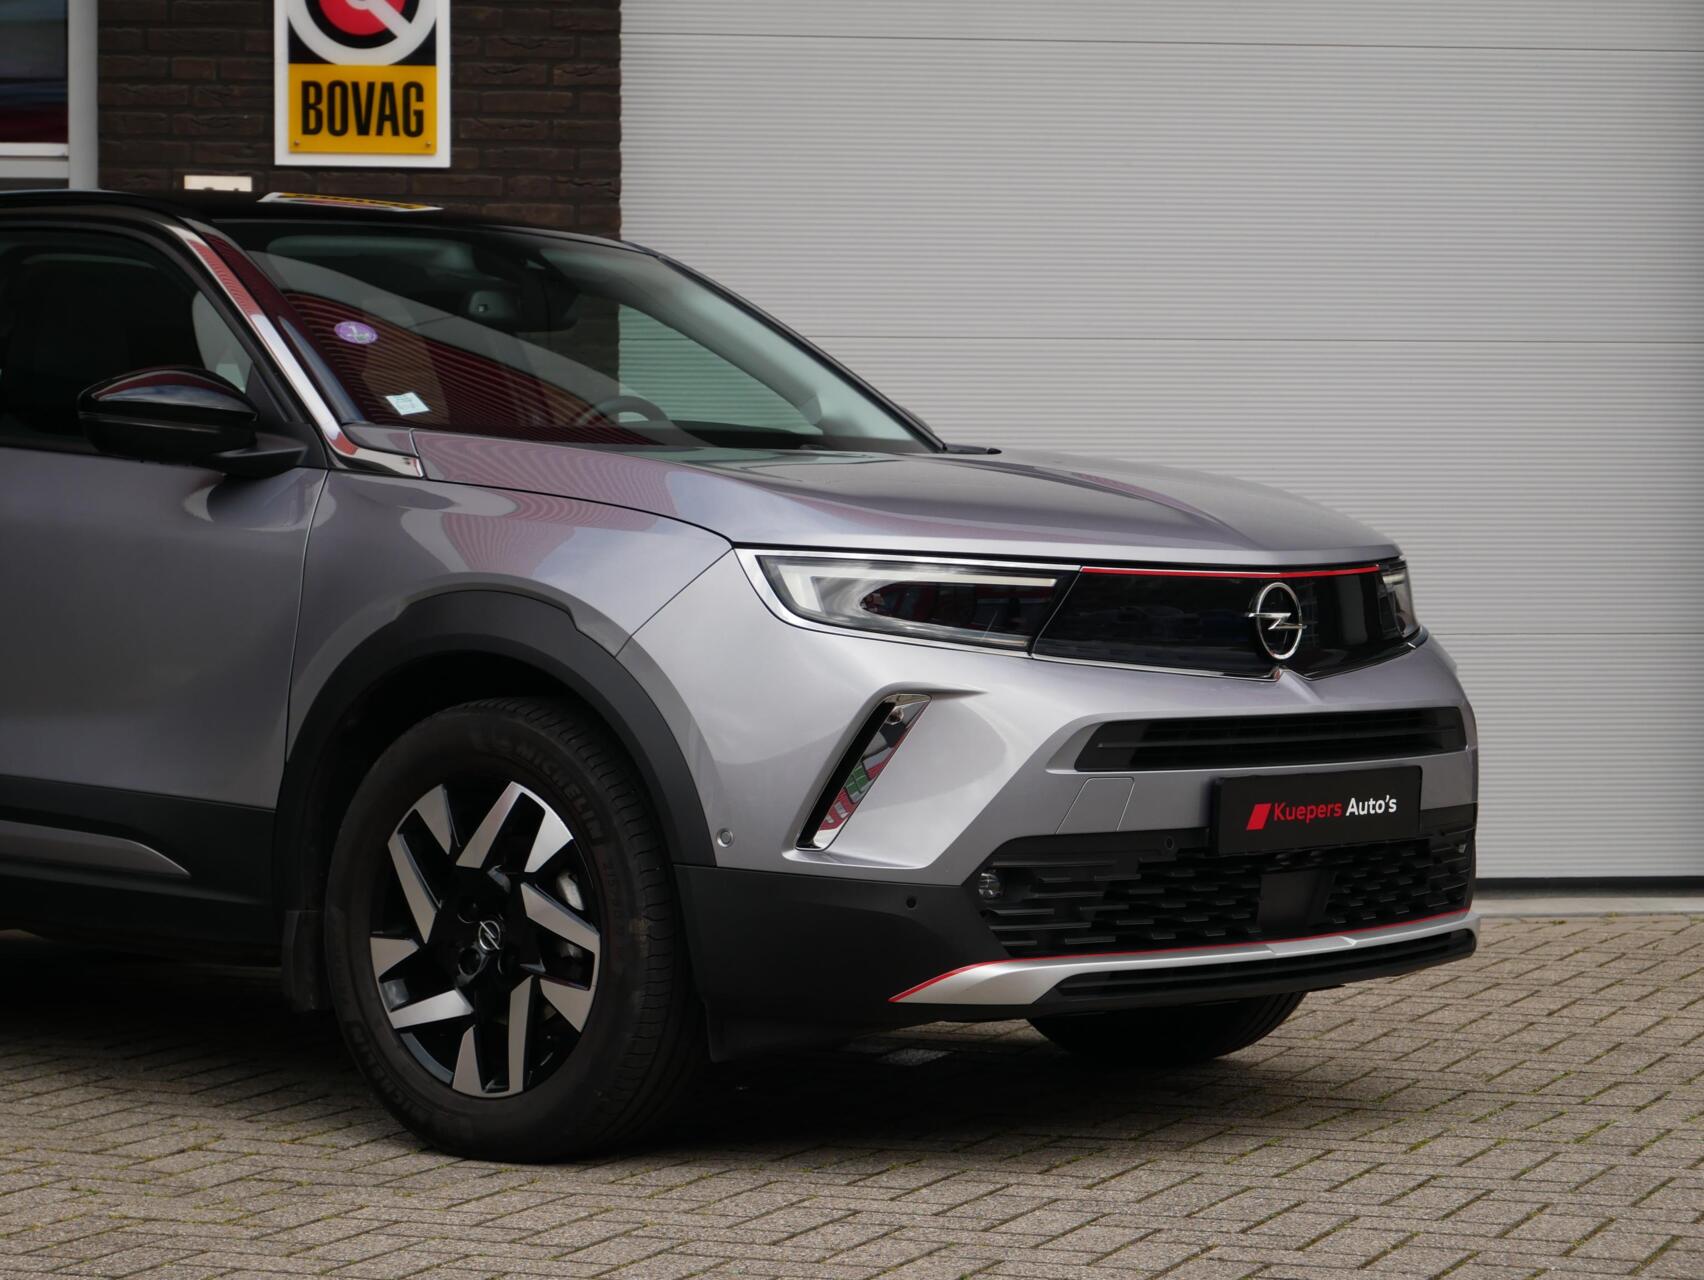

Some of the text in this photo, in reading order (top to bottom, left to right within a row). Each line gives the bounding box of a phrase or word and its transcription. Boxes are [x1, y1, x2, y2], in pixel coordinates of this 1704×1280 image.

[301, 80, 425, 138] BOVAG
[1273, 795, 1398, 824] Kuepers Auto's
